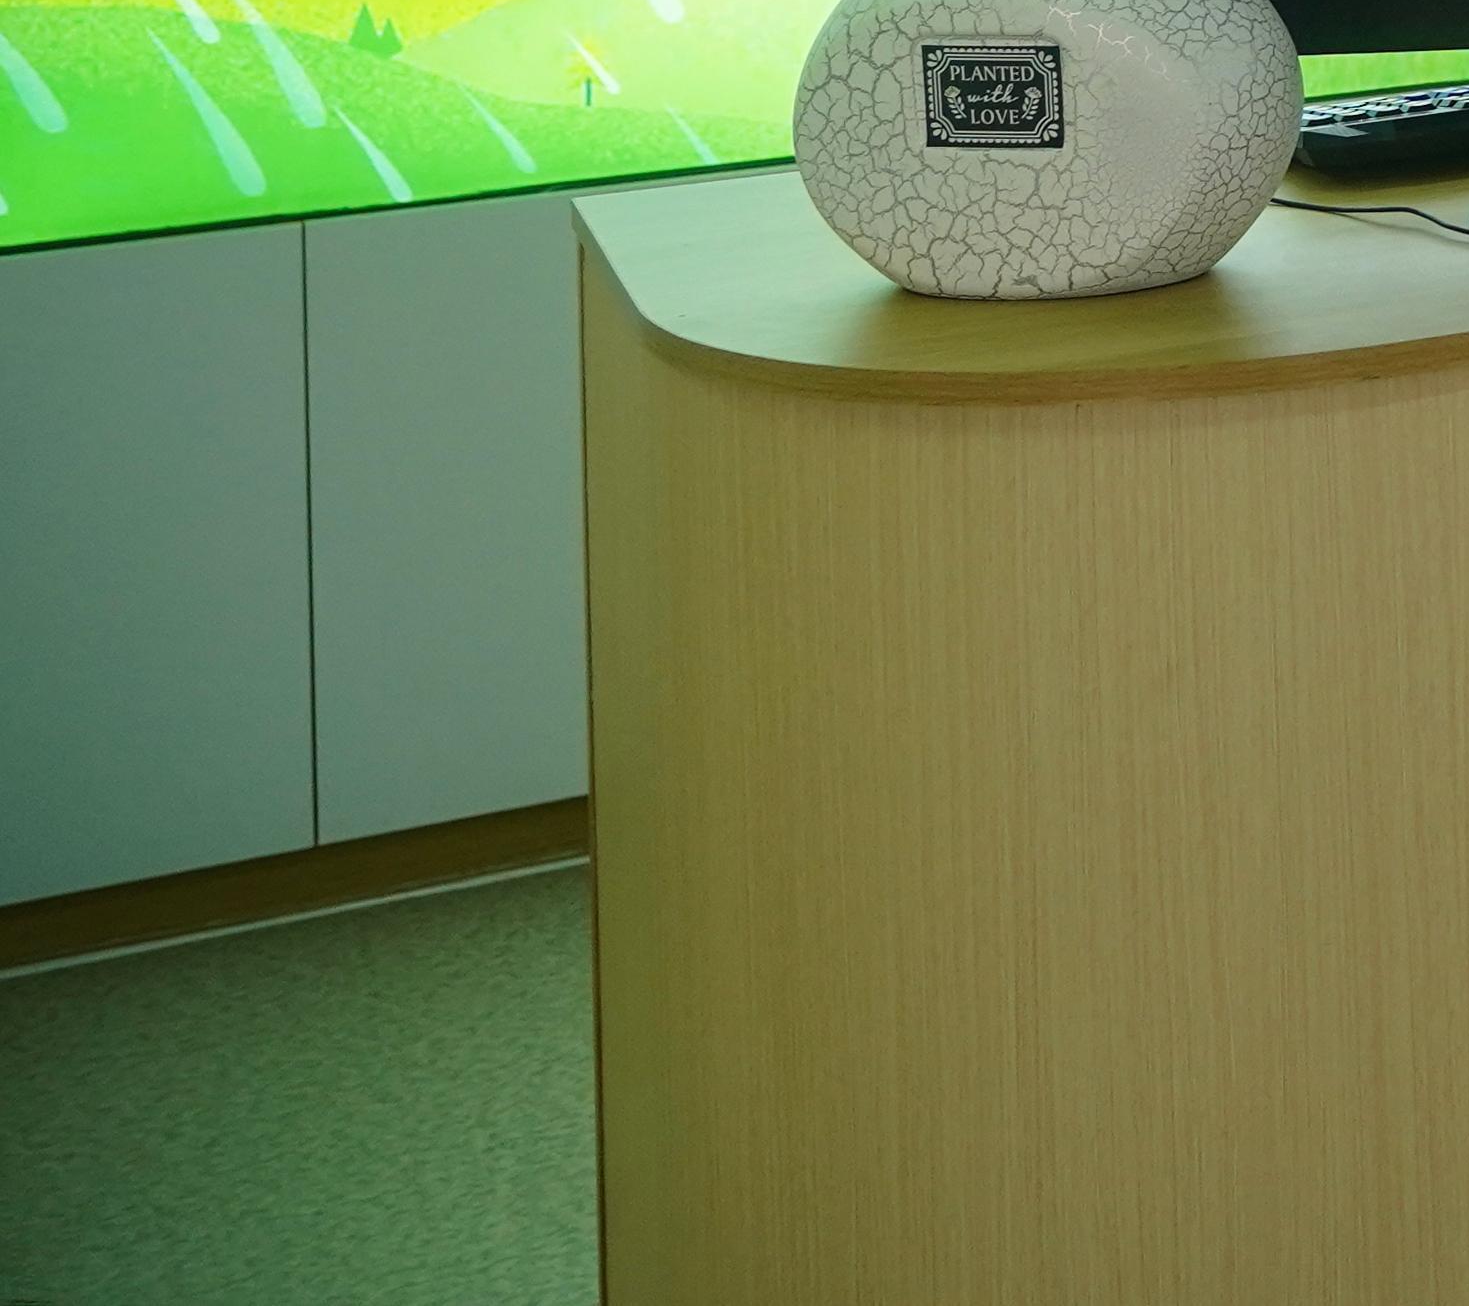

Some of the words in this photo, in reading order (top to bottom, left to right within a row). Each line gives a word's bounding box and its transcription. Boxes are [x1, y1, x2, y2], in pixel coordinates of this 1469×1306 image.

[950, 64, 1035, 82] PLANTED
[967, 83, 1019, 104] with
[970, 108, 1020, 125] LOVE
